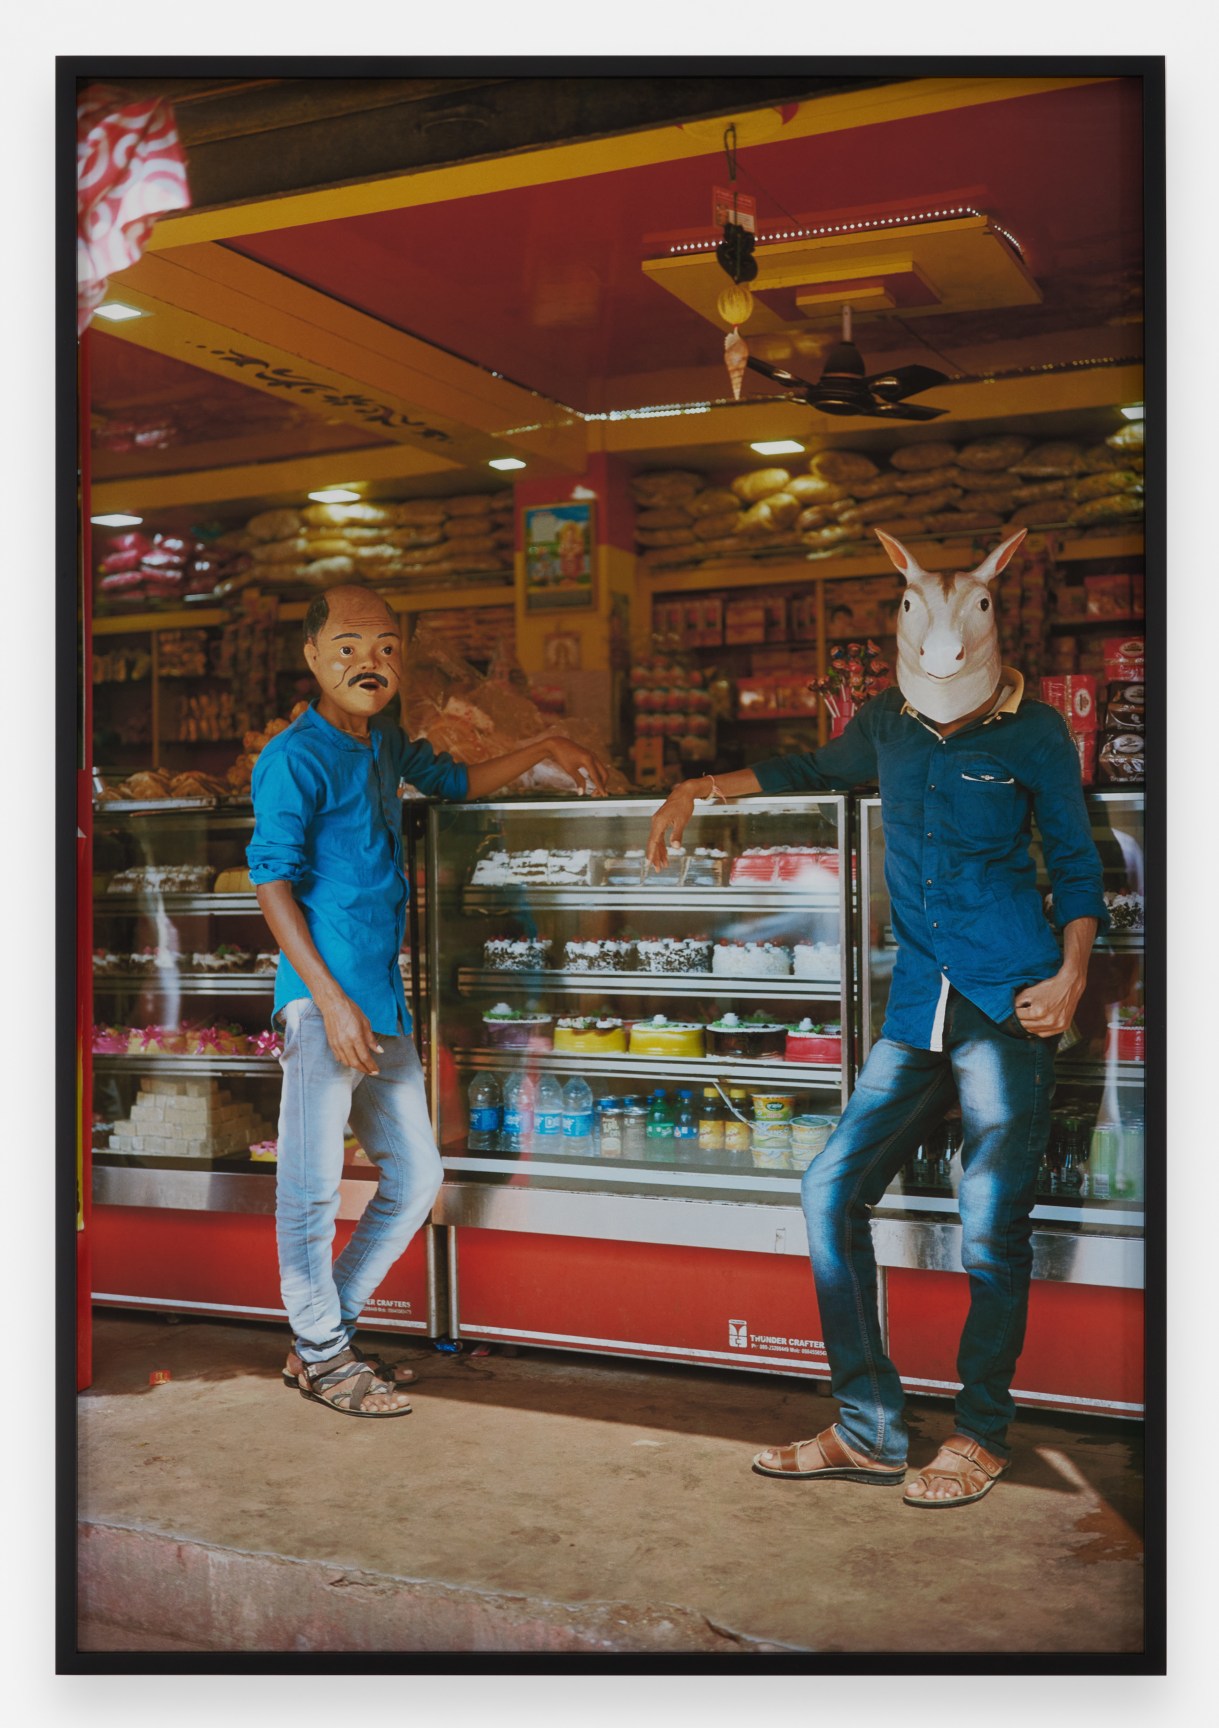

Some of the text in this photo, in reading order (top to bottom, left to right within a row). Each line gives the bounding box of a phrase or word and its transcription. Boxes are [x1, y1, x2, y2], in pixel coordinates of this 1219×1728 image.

[376, 1300, 411, 1308] CRAFTERS
[750, 1334, 826, 1349] THUNDER CRAFTER
